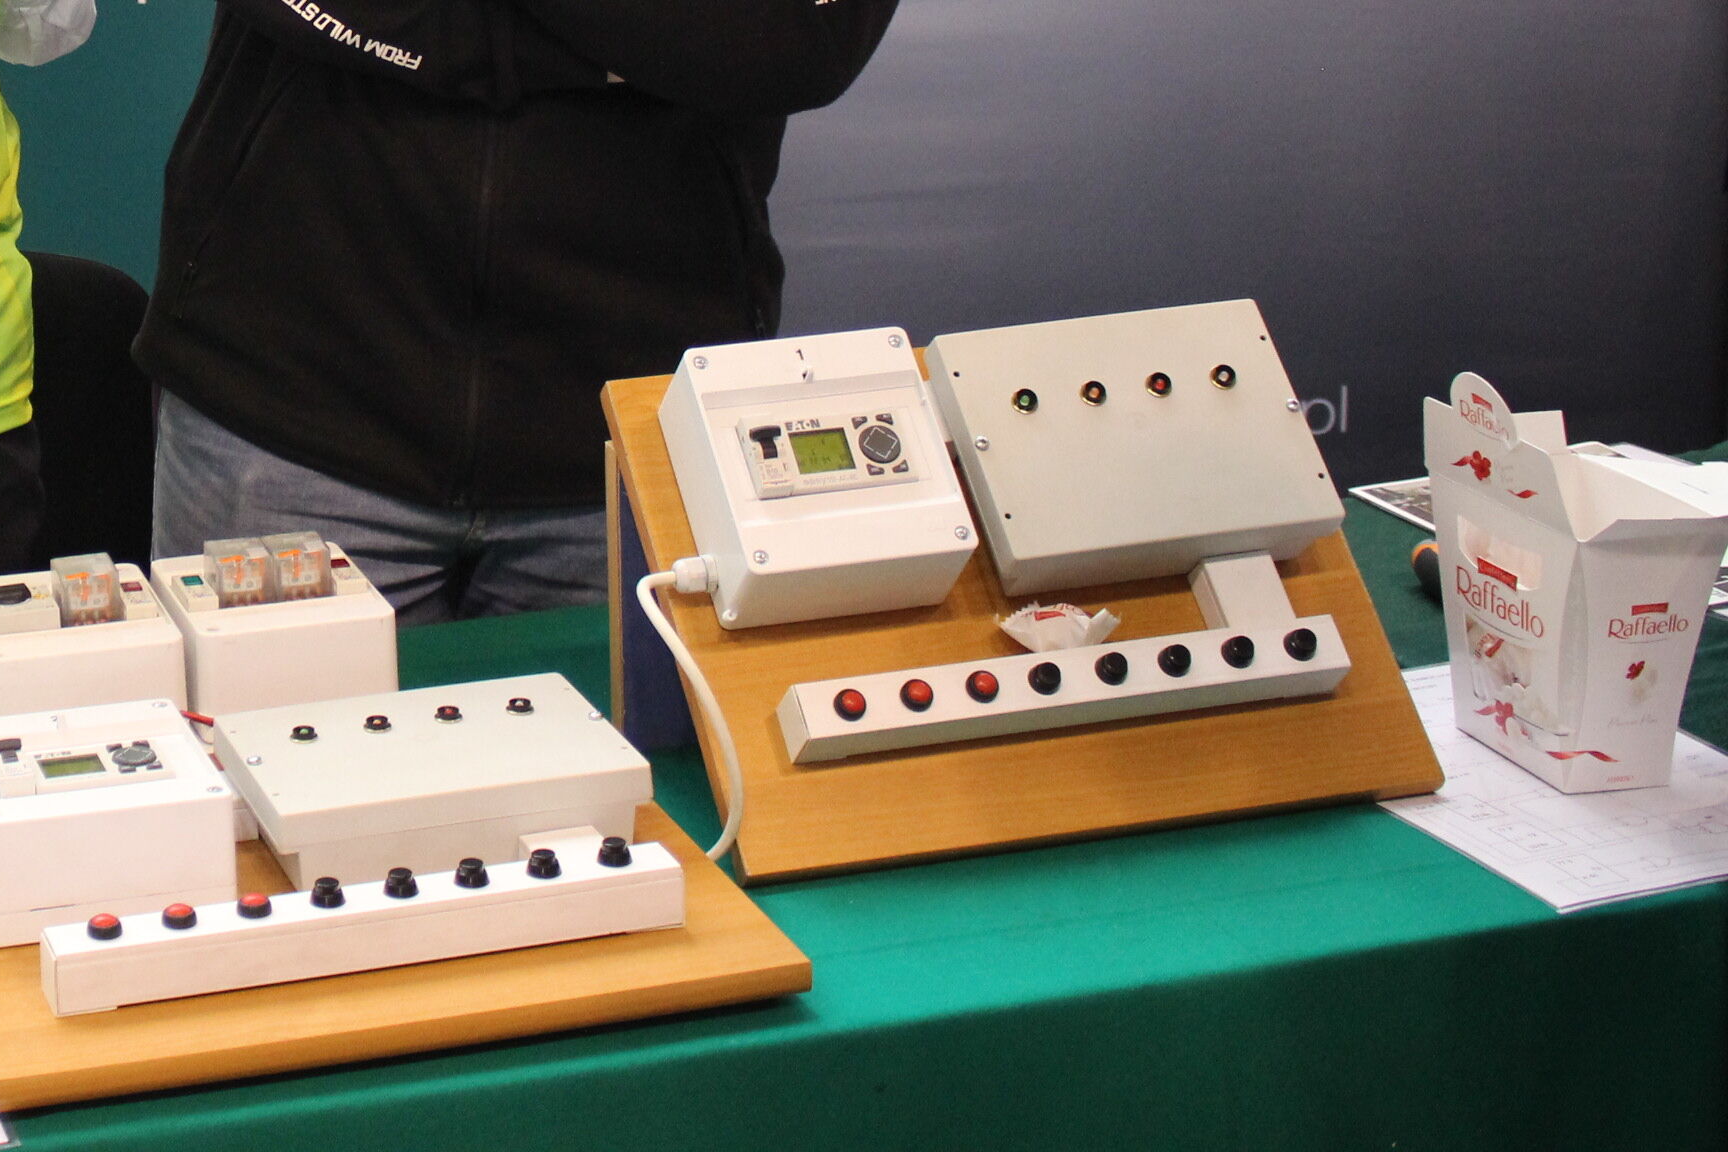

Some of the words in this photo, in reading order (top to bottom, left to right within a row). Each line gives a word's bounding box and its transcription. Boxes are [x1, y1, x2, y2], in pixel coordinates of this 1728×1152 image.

[313, 13, 361, 49] WILD
[363, 38, 423, 71] FROM
[1456, 565, 1545, 638] Raffaello
[1608, 614, 1689, 640] Raffaello
